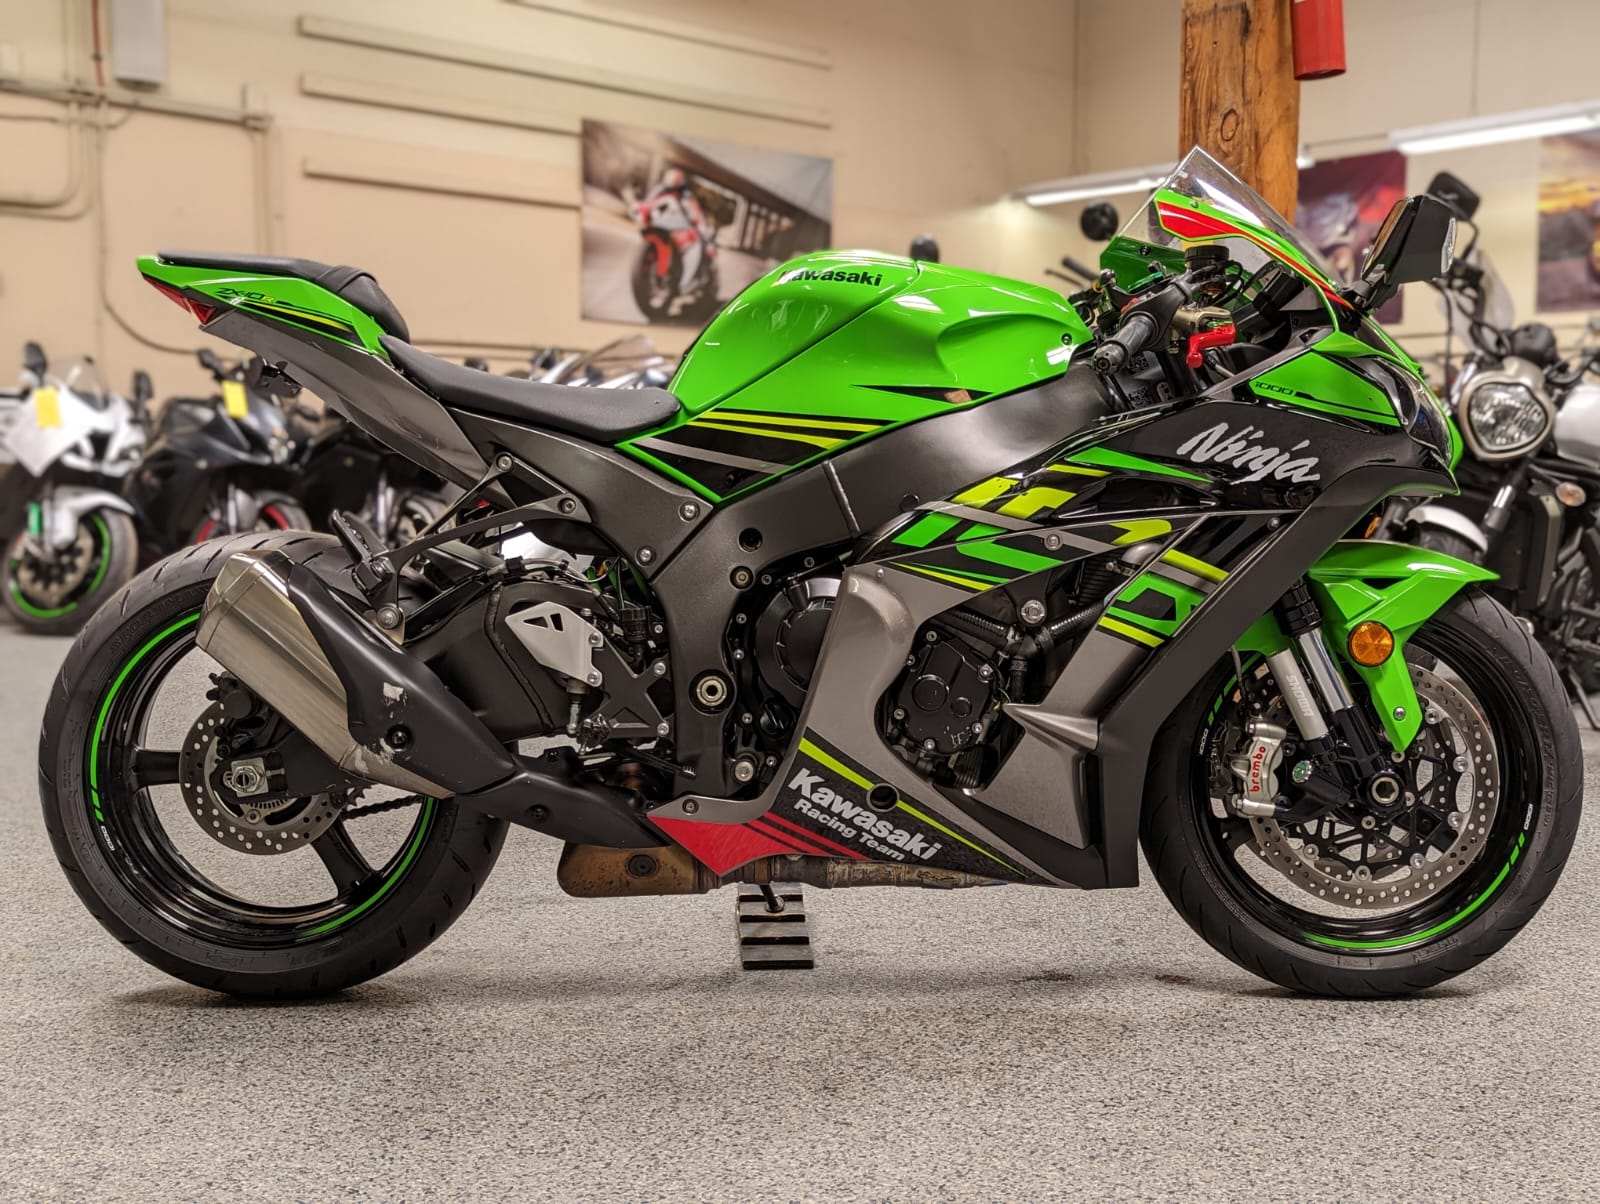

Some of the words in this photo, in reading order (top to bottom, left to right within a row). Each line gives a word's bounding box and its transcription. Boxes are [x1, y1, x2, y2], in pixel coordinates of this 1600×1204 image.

[777, 266, 883, 287] awasaki
[1255, 381, 1294, 395] 1000
[1176, 422, 1321, 485] Ninja
[1285, 674, 1315, 717] SHOWA
[1250, 746, 1266, 793] brembo
[788, 767, 943, 860] Kawasaki
[793, 798, 857, 838] Racing
[858, 832, 906, 861] Team
